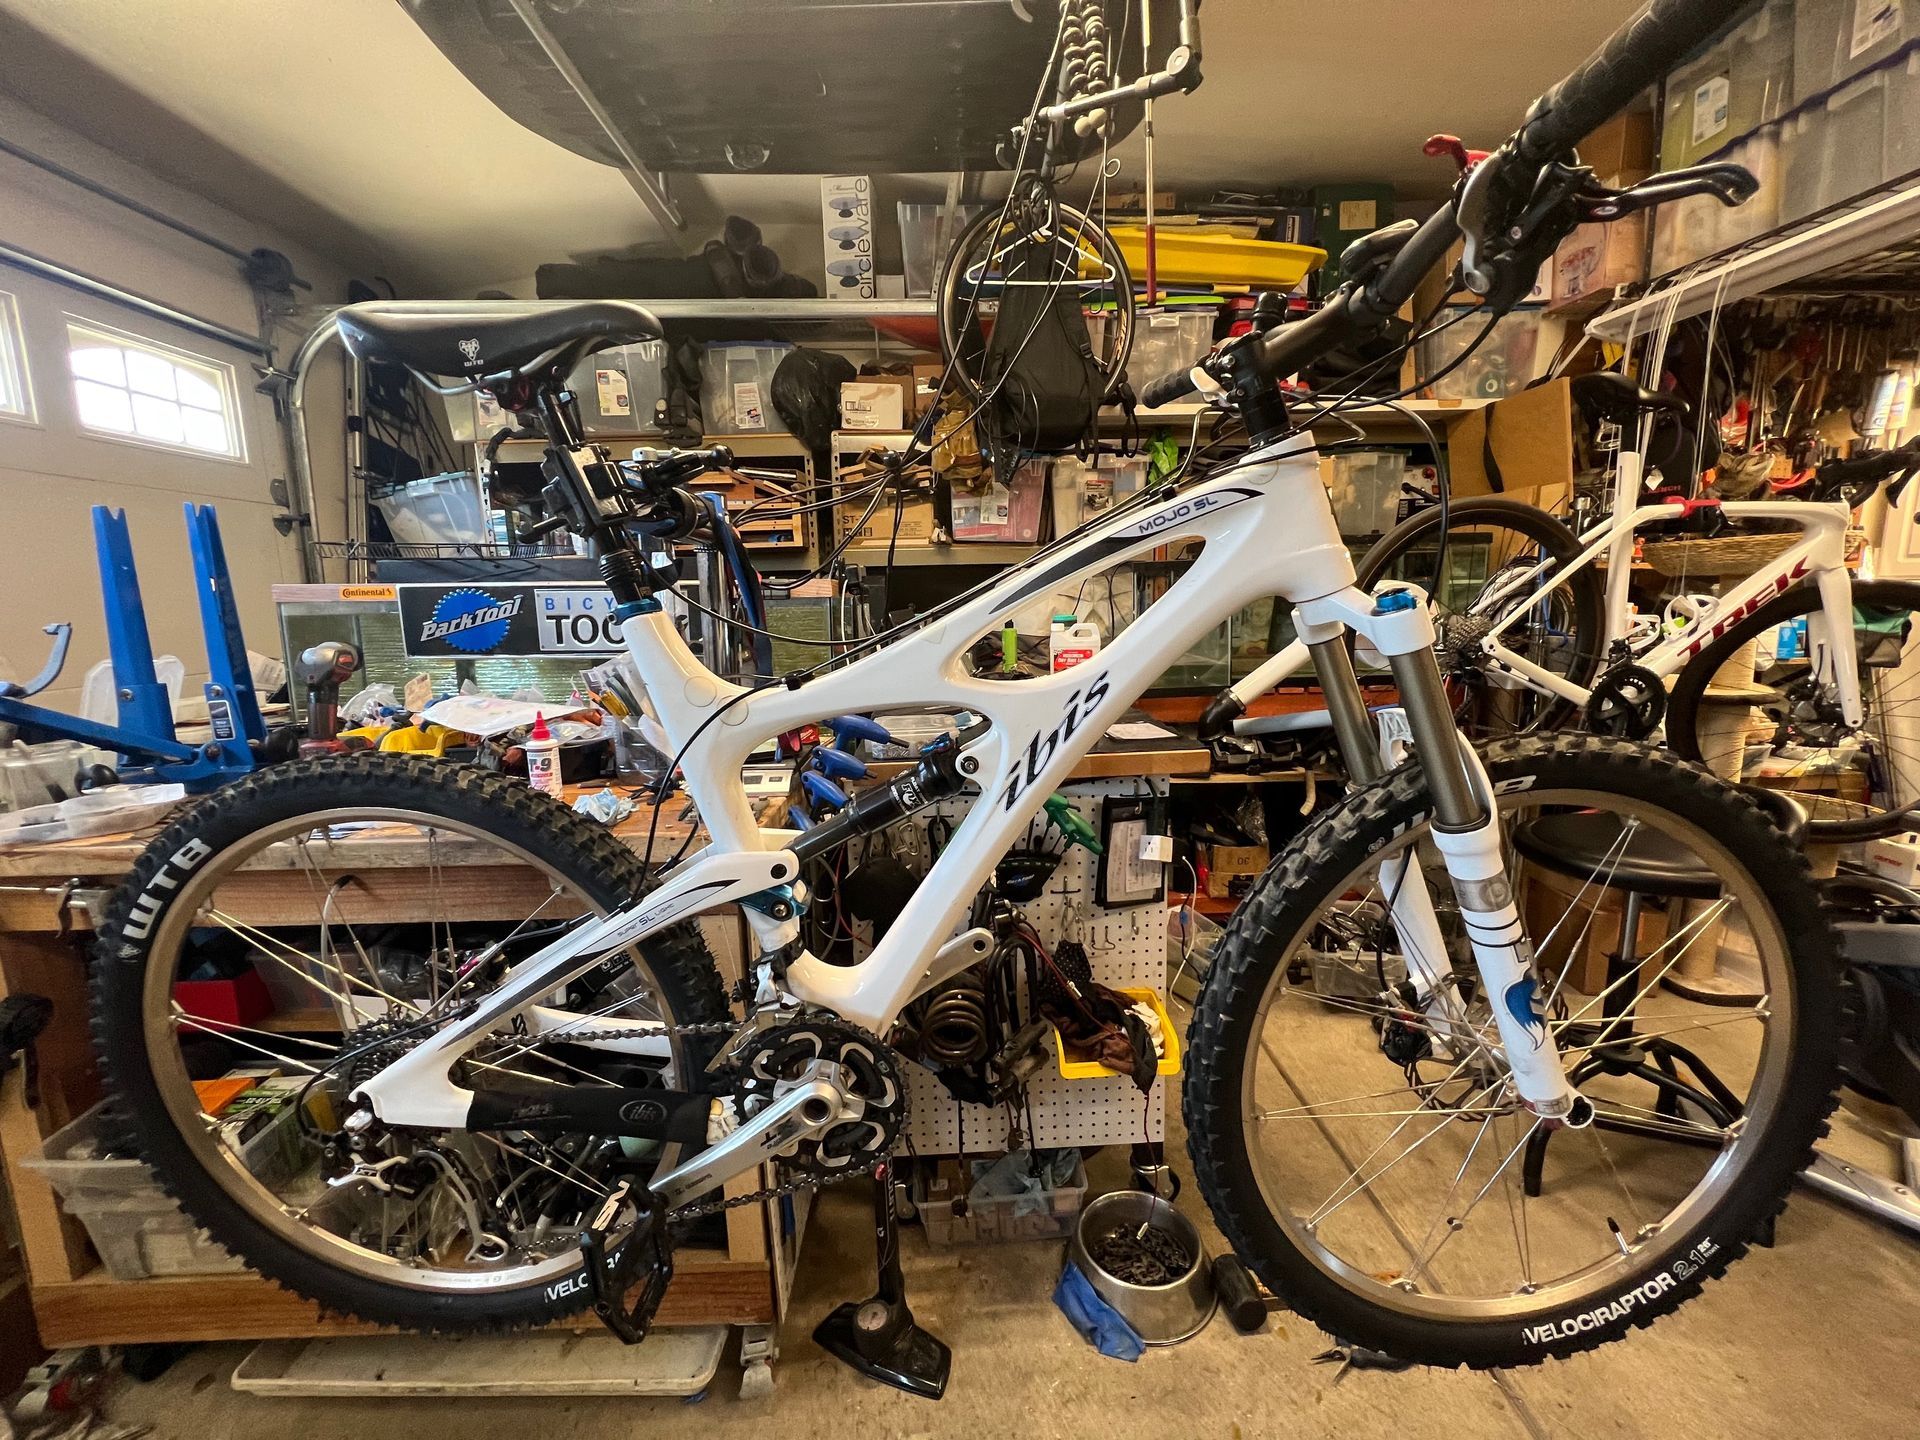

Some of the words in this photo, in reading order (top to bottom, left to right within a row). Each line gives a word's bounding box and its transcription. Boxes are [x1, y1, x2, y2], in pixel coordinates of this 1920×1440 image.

[854, 178, 873, 299] circleware
[1138, 505, 1191, 534] MOJO
[1194, 496, 1219, 511] SL
[342, 588, 386, 599] Continental
[1677, 555, 1811, 659] TREK
[996, 670, 1110, 812] ibis
[122, 837, 212, 939] WTB
[638, 915, 656, 926] SL
[1524, 1271, 1678, 1345] VELOCIRAPTOR
[1672, 1249, 1707, 1281] 2.1
